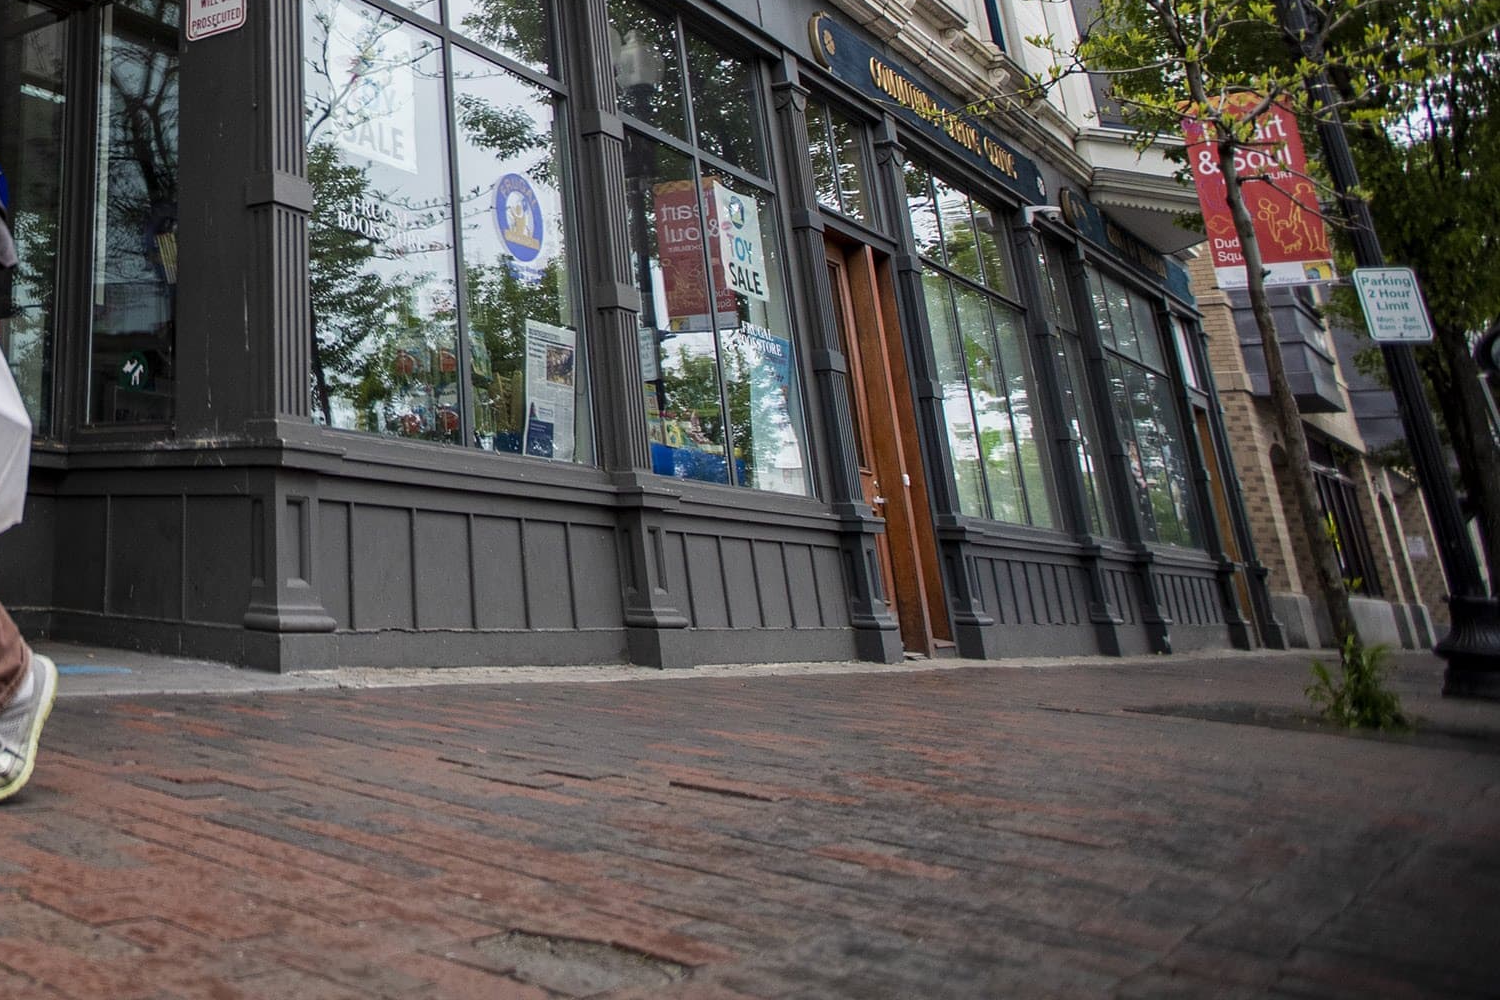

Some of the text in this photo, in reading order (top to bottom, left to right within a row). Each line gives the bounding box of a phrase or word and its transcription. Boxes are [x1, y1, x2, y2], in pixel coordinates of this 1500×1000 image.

[191, 7, 241, 33] PROSECUTED
[1198, 143, 1293, 175] & Soul
[726, 232, 753, 264] TOY
[729, 261, 764, 296] SALE
[1361, 277, 1411, 287] Parking
[1368, 289, 1411, 298] 2 Hour
[1376, 301, 1410, 311] Limit
[741, 320, 773, 341] FRUGAL
